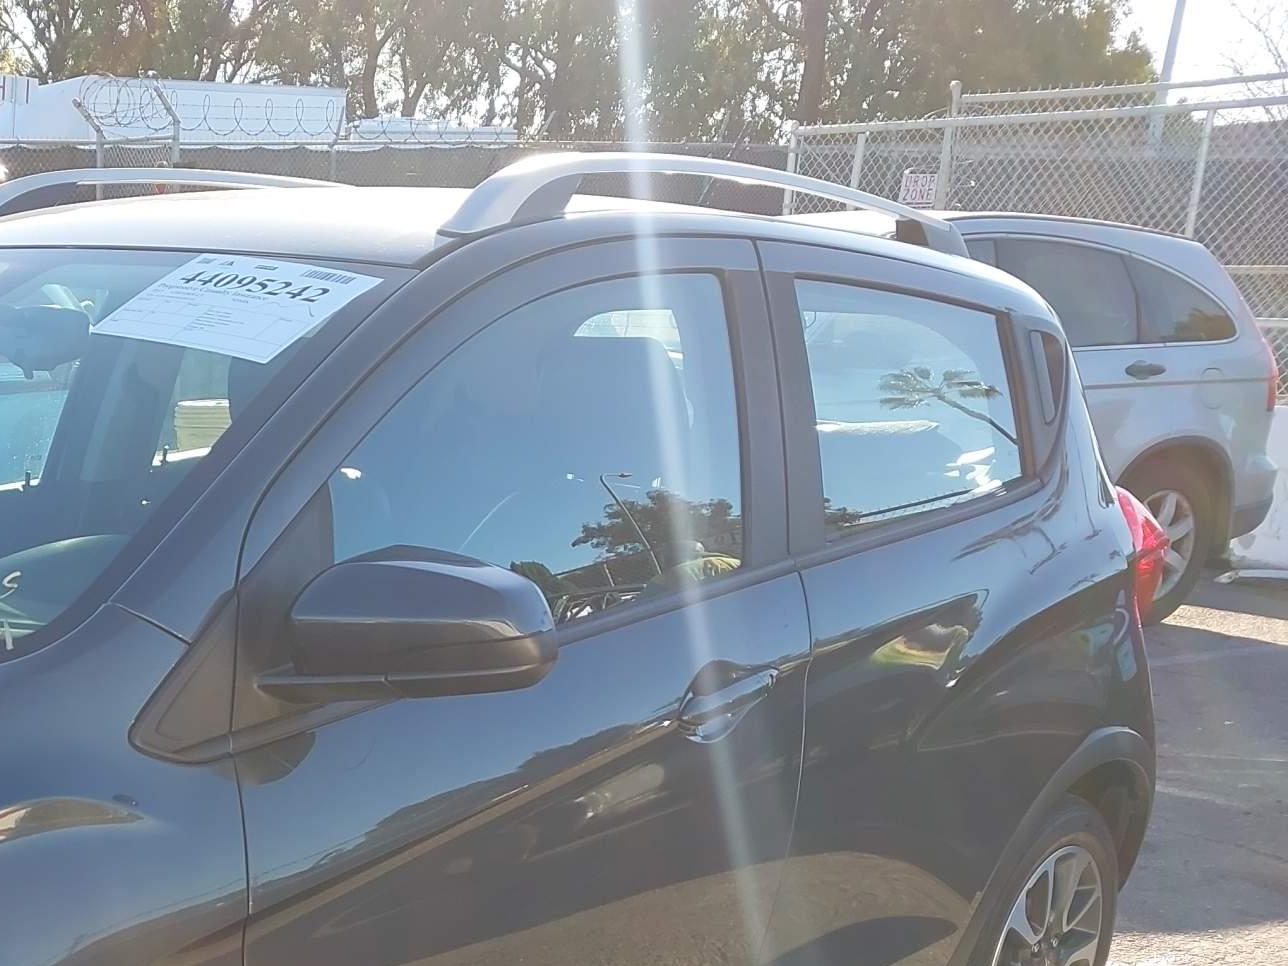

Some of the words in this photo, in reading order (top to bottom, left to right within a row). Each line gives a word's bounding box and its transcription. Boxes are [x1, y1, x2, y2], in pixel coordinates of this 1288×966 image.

[904, 175, 936, 188] DROP
[902, 188, 933, 201] ZONE
[180, 270, 330, 303] 44095242
